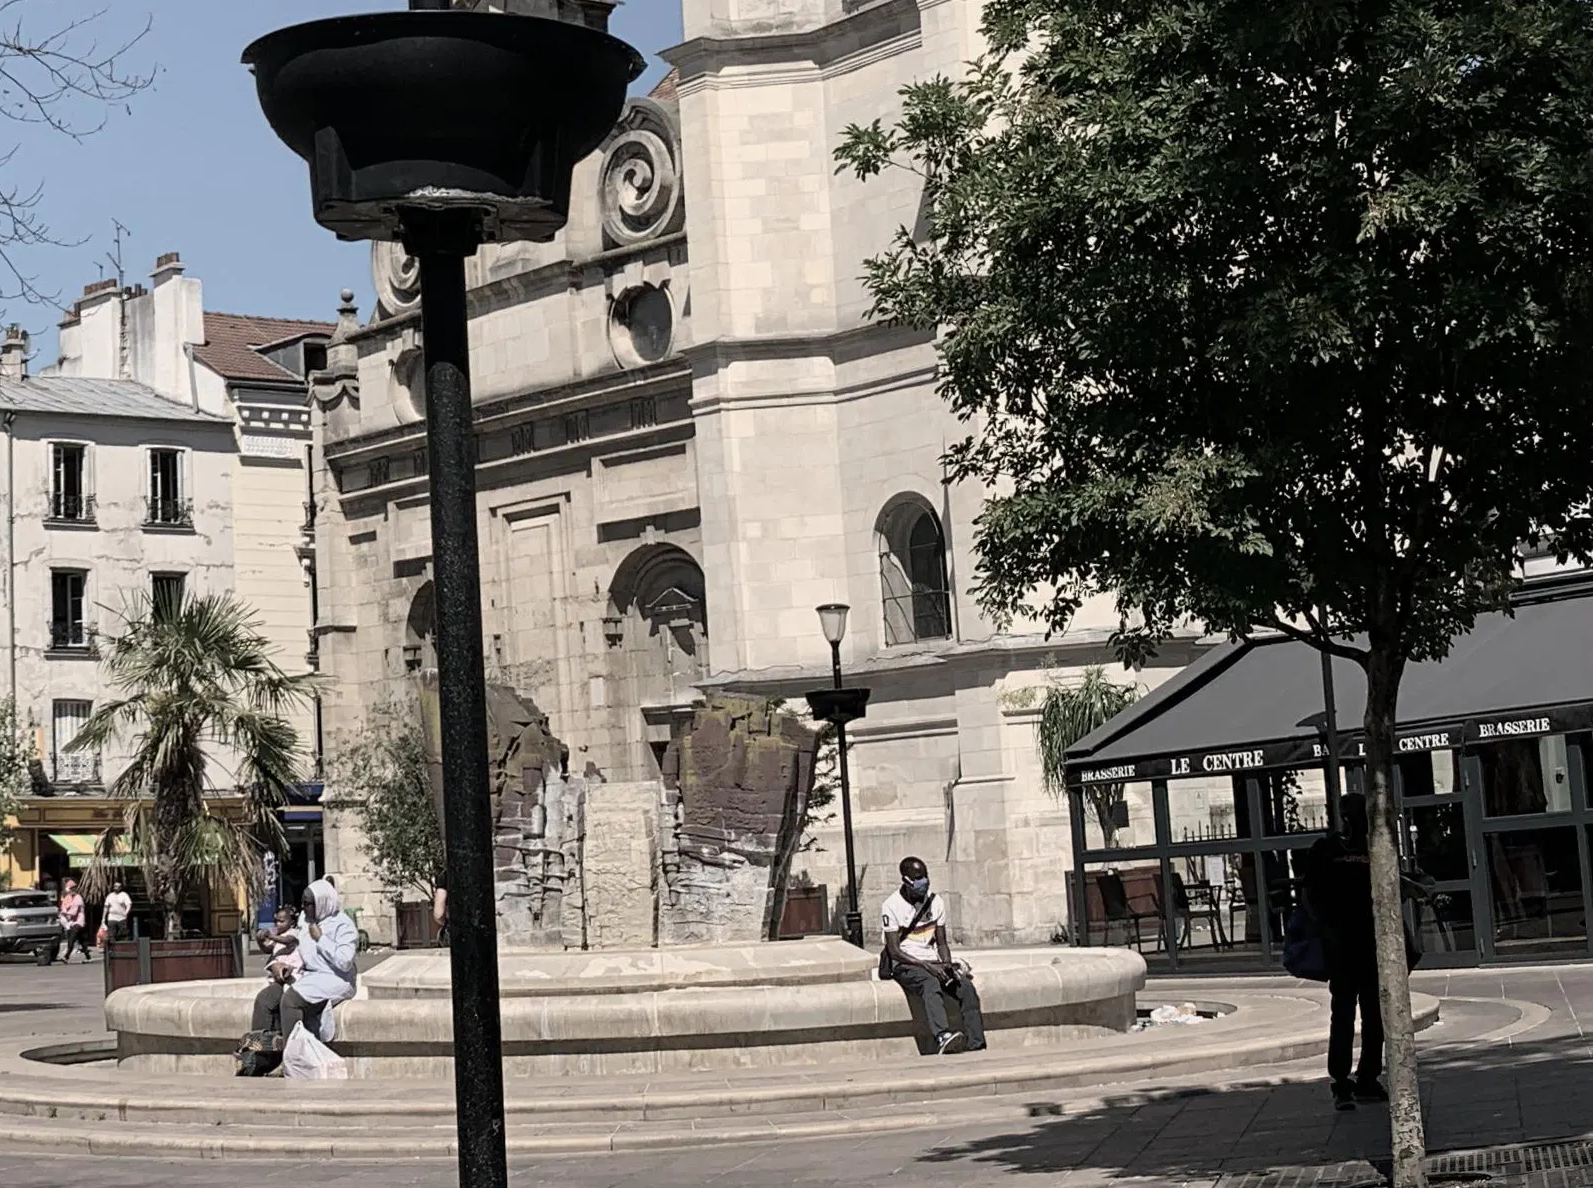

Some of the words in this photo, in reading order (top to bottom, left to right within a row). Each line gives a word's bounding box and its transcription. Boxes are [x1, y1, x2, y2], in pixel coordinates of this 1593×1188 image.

[1479, 718, 1551, 737] BRASSERIE
[1081, 765, 1135, 782] BRASSERIE
[1170, 757, 1191, 775] LE
[1202, 750, 1264, 772] CENTRE
[1313, 744, 1331, 757] BA
[1399, 733, 1449, 751] CENTRE
